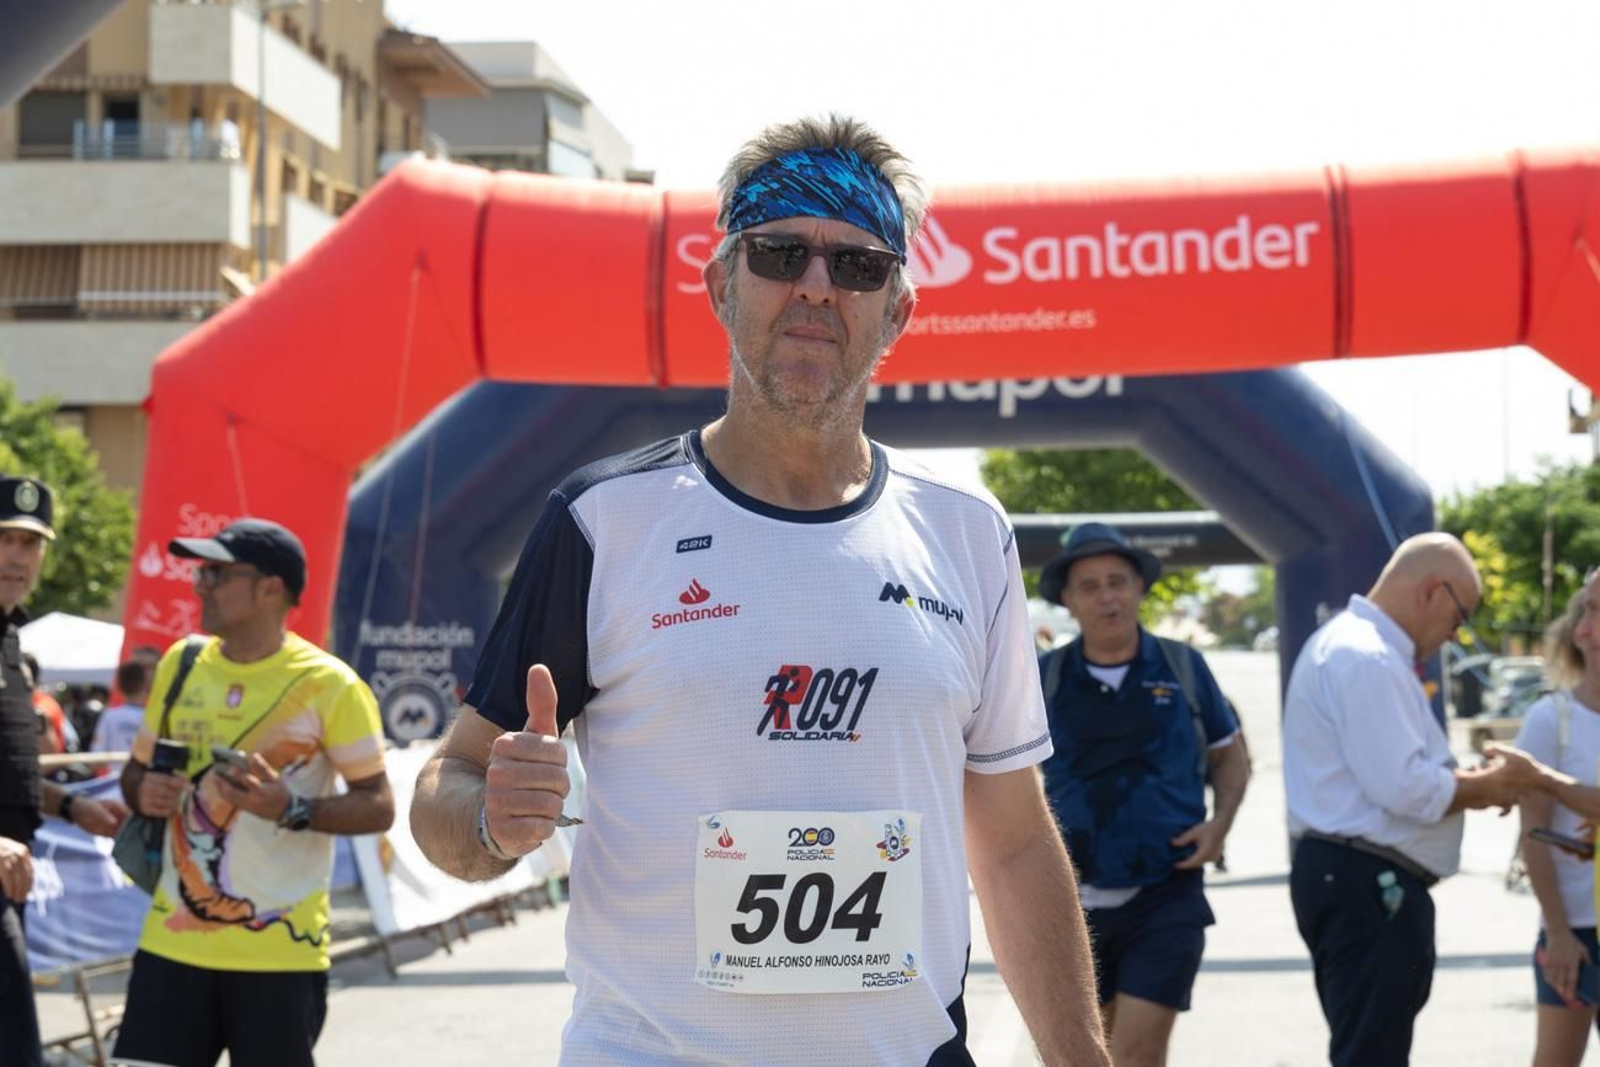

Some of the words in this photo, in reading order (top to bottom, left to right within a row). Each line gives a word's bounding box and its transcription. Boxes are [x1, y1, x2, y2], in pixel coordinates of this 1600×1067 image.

[983, 215, 1320, 285] Santander
[908, 309, 1097, 335] ortssantander.es
[652, 603, 741, 629] Santander
[768, 730, 856, 741] SOLIDARIA
[704, 847, 747, 861] Santander
[730, 871, 887, 945] 504
[726, 954, 763, 968] MANUEL
[764, 955, 812, 968] ALFONSO
[815, 954, 864, 967] HINOJOSA
[865, 953, 891, 966] RAYO
[862, 970, 906, 980] POLICIA
